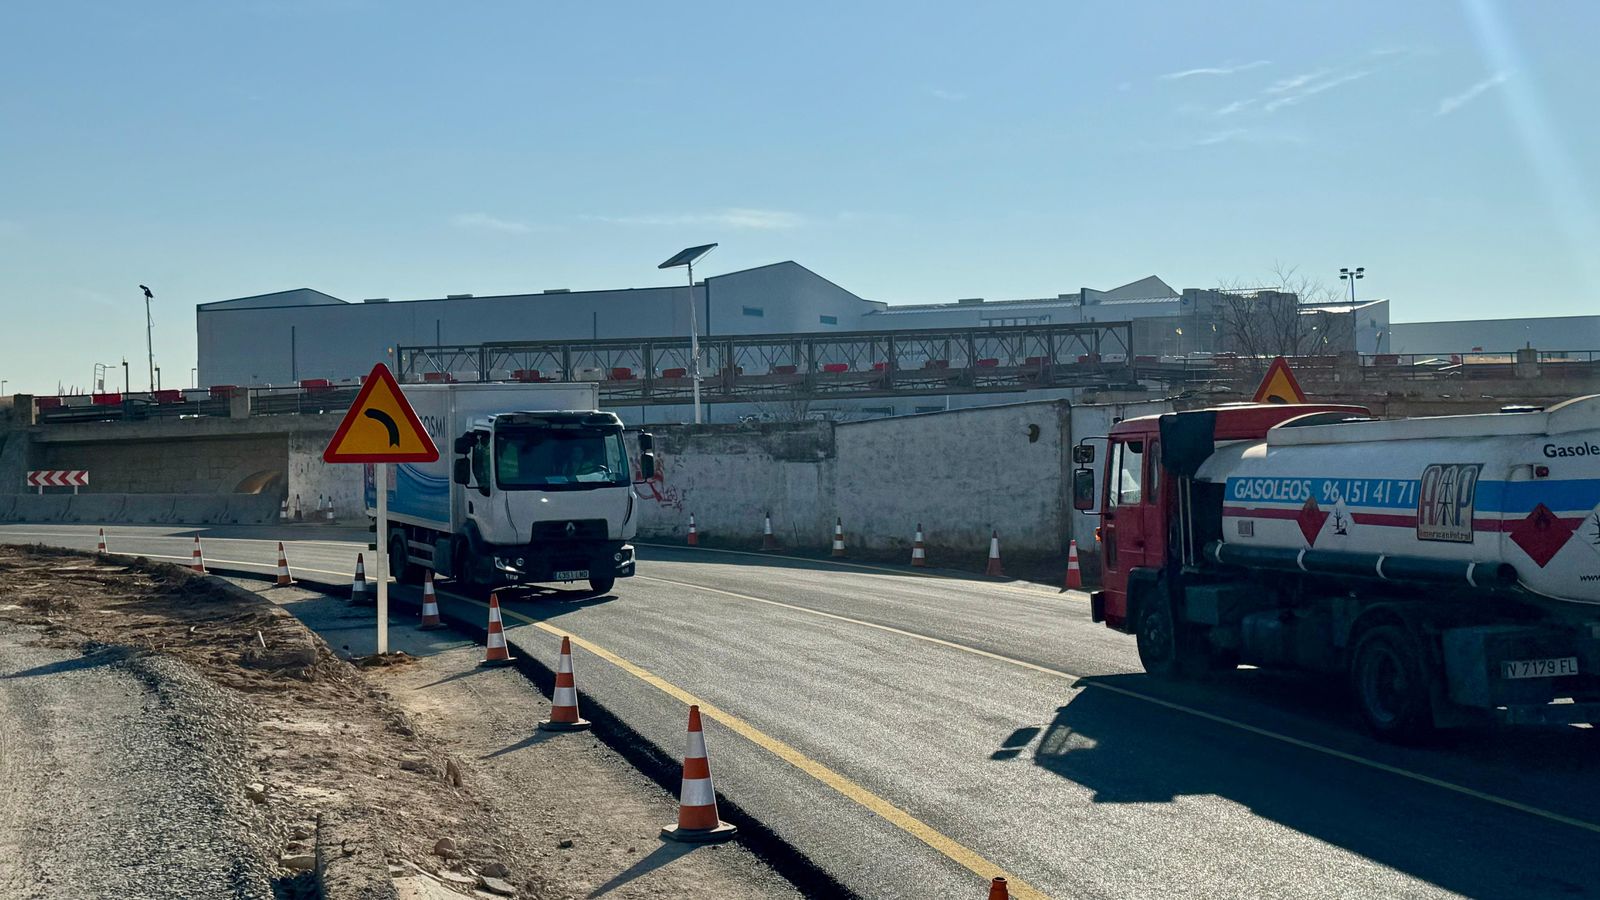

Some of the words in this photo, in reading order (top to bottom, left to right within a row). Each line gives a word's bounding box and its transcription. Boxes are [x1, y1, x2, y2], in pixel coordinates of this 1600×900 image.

[419, 415, 446, 438] OSMI
[1234, 479, 1311, 501] GASOLEOS
[1323, 480, 1339, 502] 96
[1345, 481, 1367, 503] 151
[1373, 481, 1390, 503] 41
[1398, 482, 1415, 504] 71
[1509, 663, 1516, 677] V
[1523, 661, 1555, 675] 7179
[1560, 659, 1576, 673] FL
